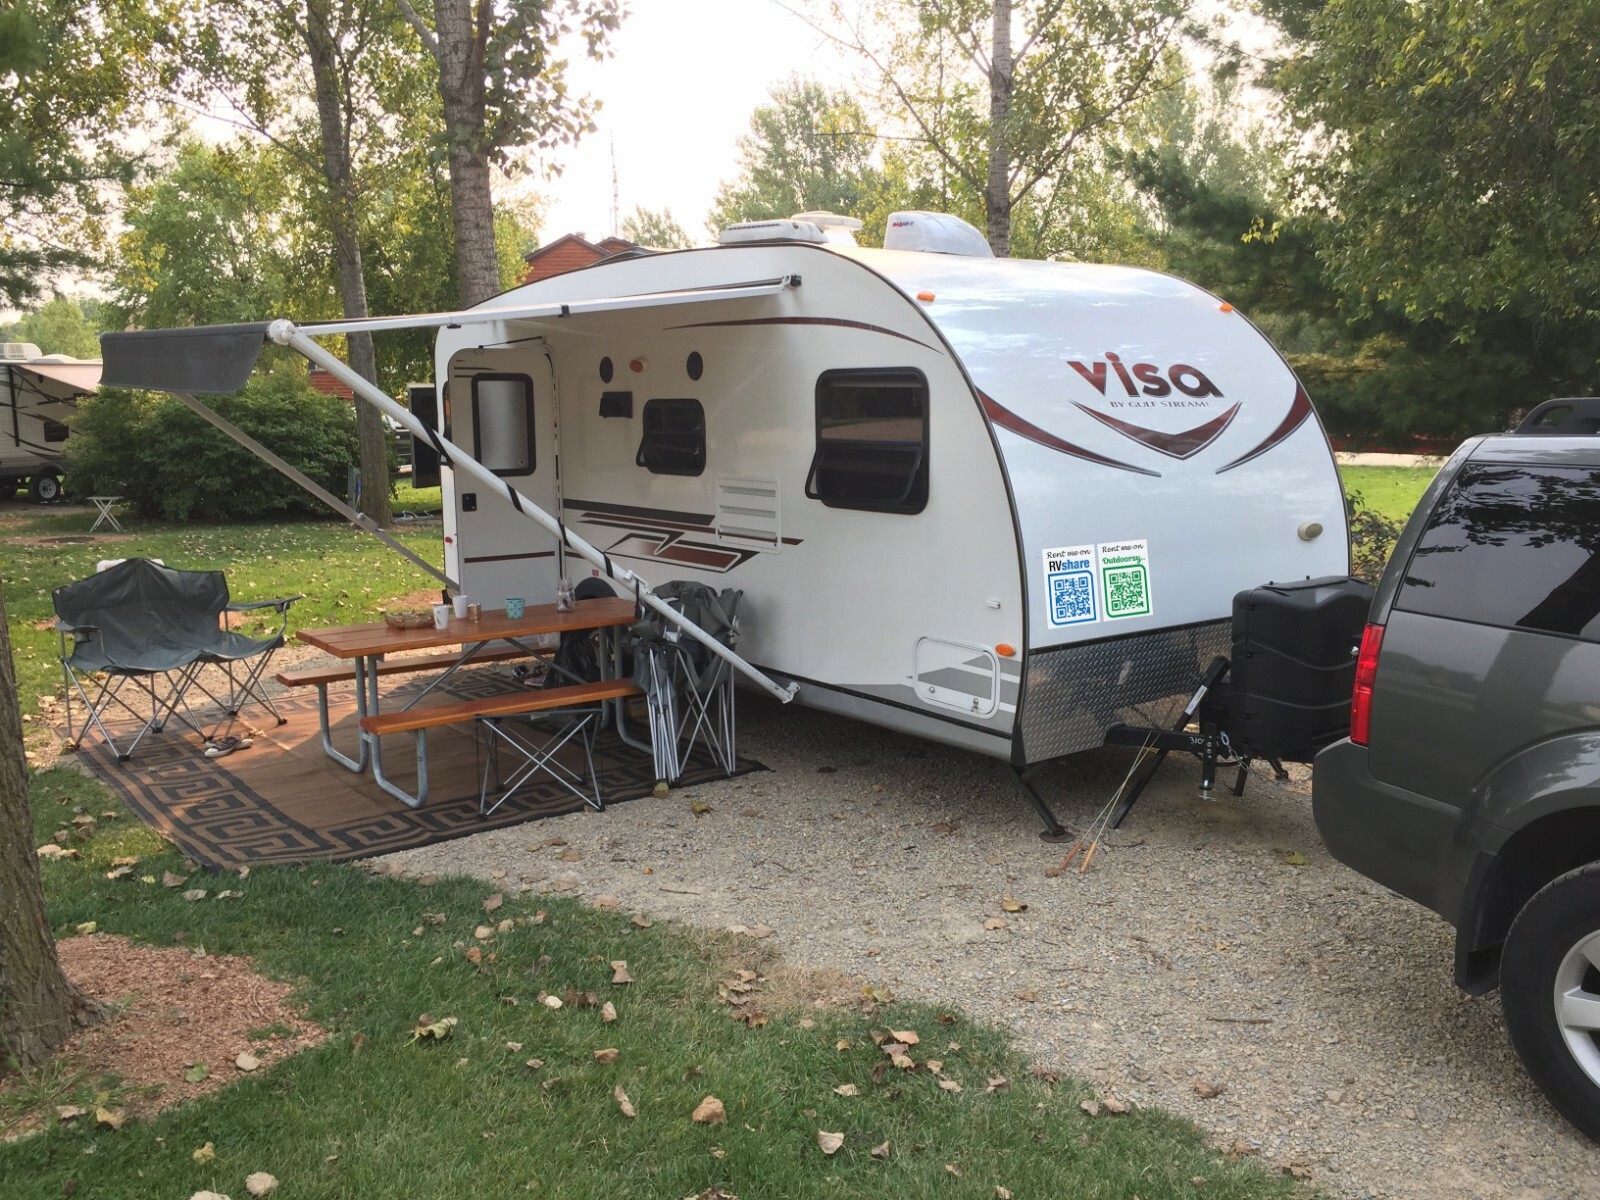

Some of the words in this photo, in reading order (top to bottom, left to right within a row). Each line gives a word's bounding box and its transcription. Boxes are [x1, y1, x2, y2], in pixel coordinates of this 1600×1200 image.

[1102, 545, 1120, 553] Rent
[1046, 550, 1065, 559] Rent
[1049, 559, 1090, 572] RVshare
